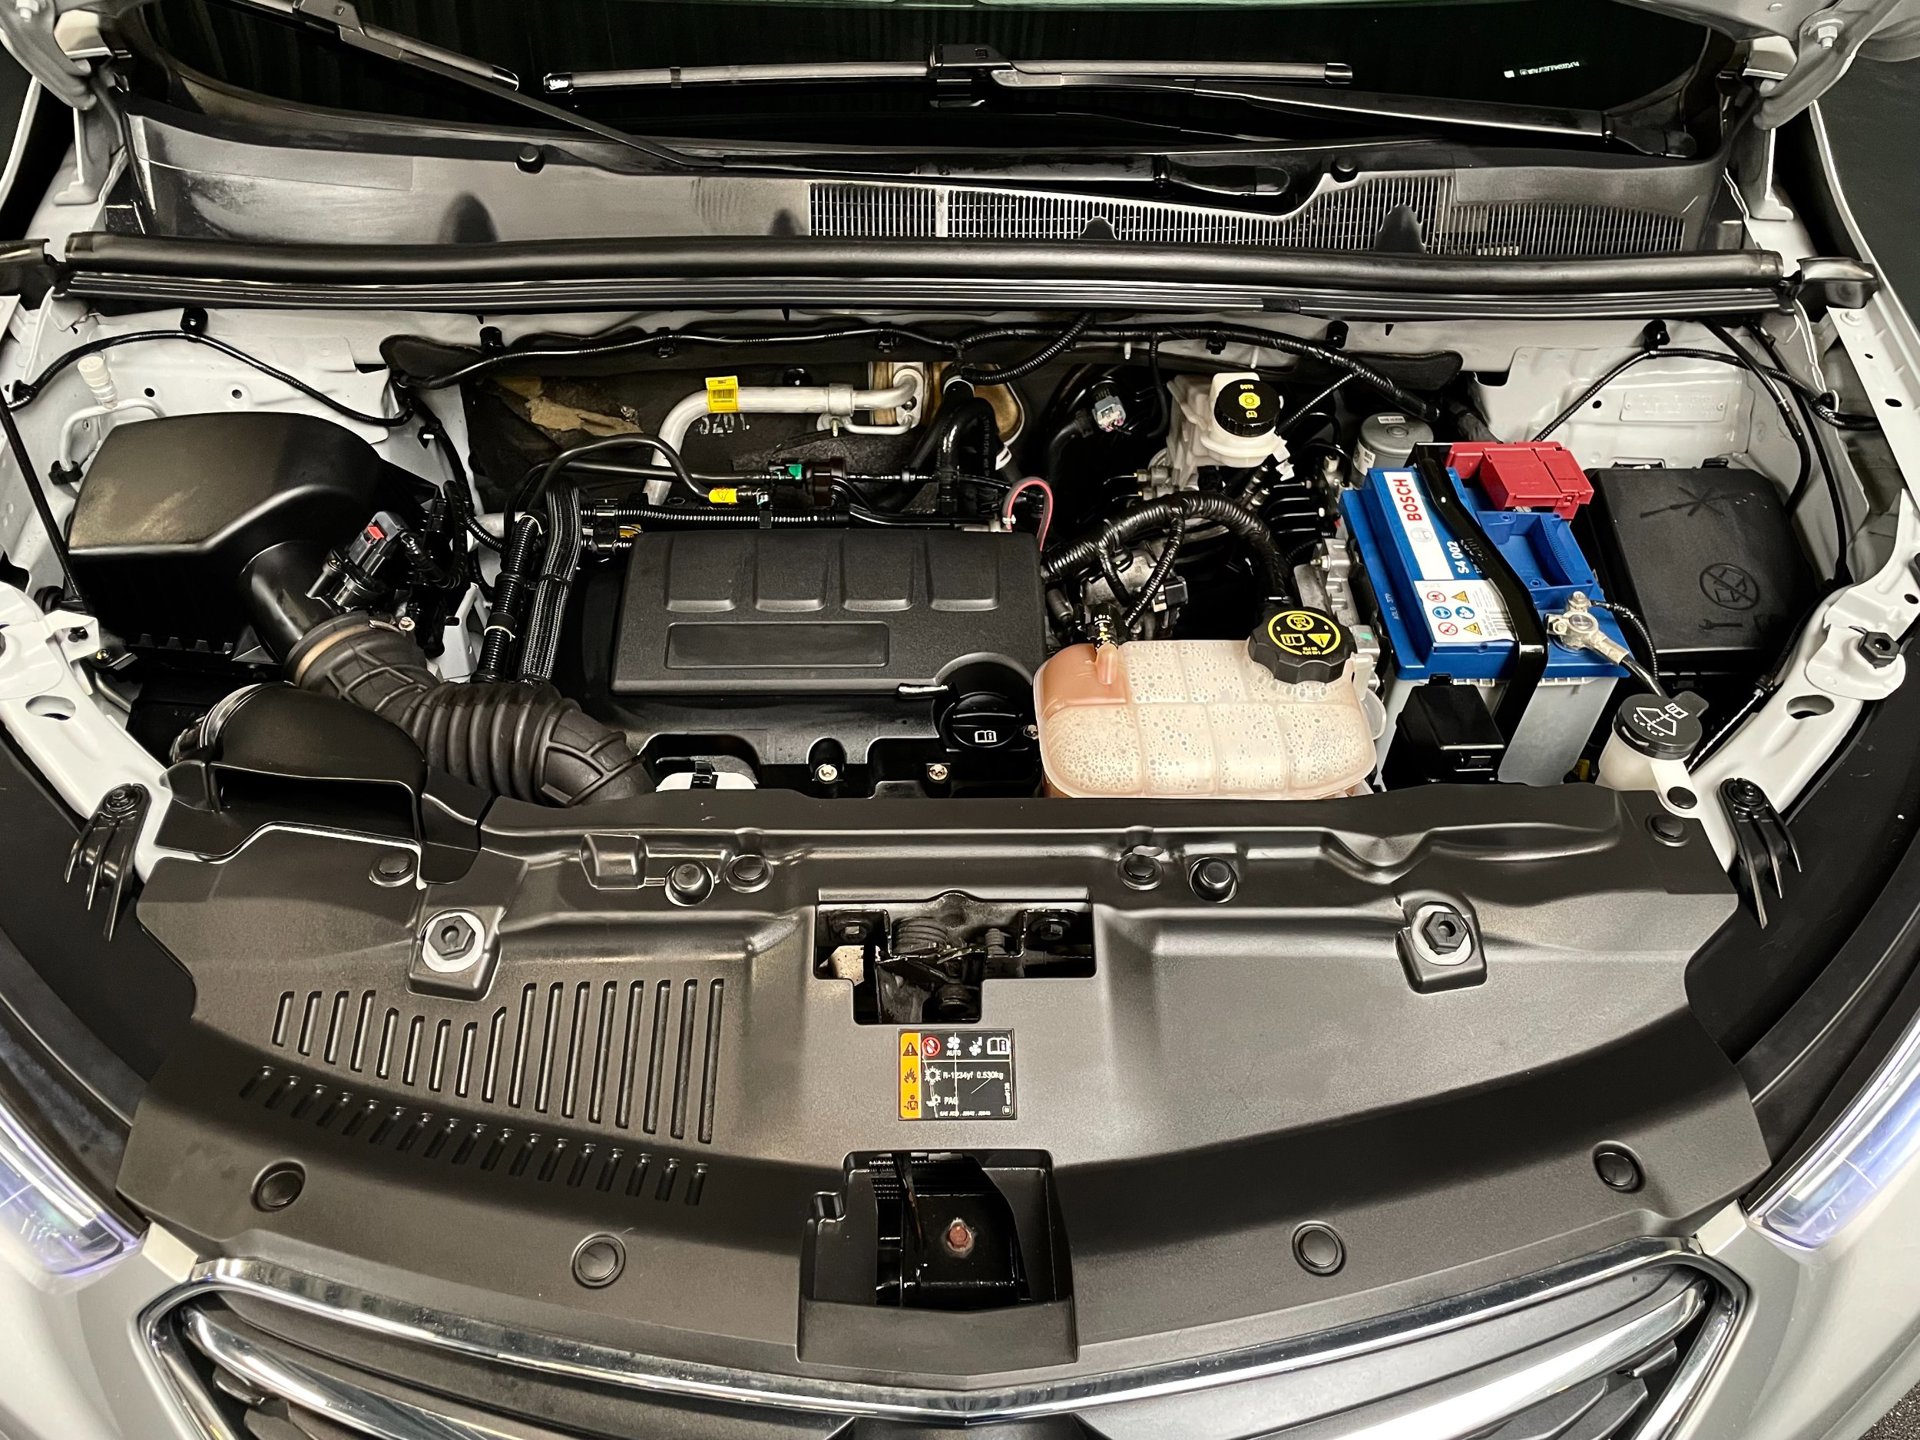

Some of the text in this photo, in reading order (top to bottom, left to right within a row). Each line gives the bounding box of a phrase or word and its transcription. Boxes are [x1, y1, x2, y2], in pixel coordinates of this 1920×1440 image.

[1392, 478, 1423, 522] BOSCH
[1446, 540, 1470, 574] S4 002
